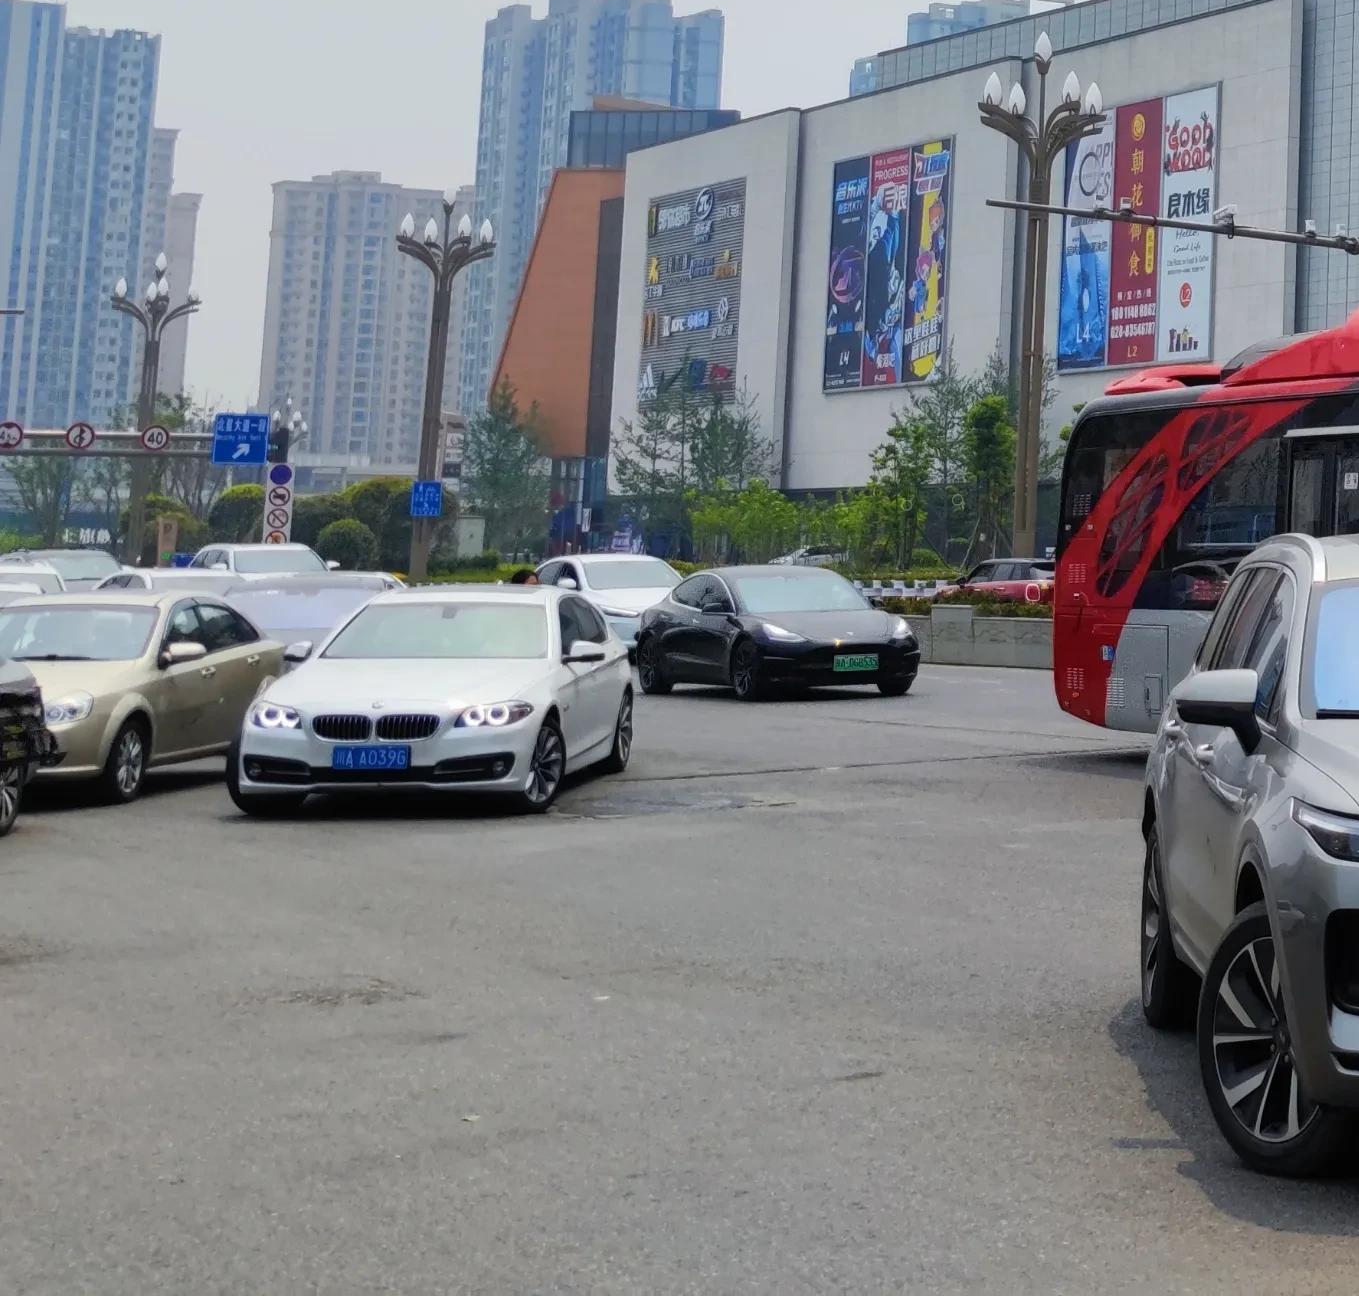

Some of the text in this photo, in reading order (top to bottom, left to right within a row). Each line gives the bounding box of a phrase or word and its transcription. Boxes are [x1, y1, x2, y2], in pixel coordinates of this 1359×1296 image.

[875, 165, 909, 181] PROGRESS
[1168, 188, 1210, 219] 良木缘
[1076, 322, 1089, 343] L4
[147, 432, 163, 444] 40
